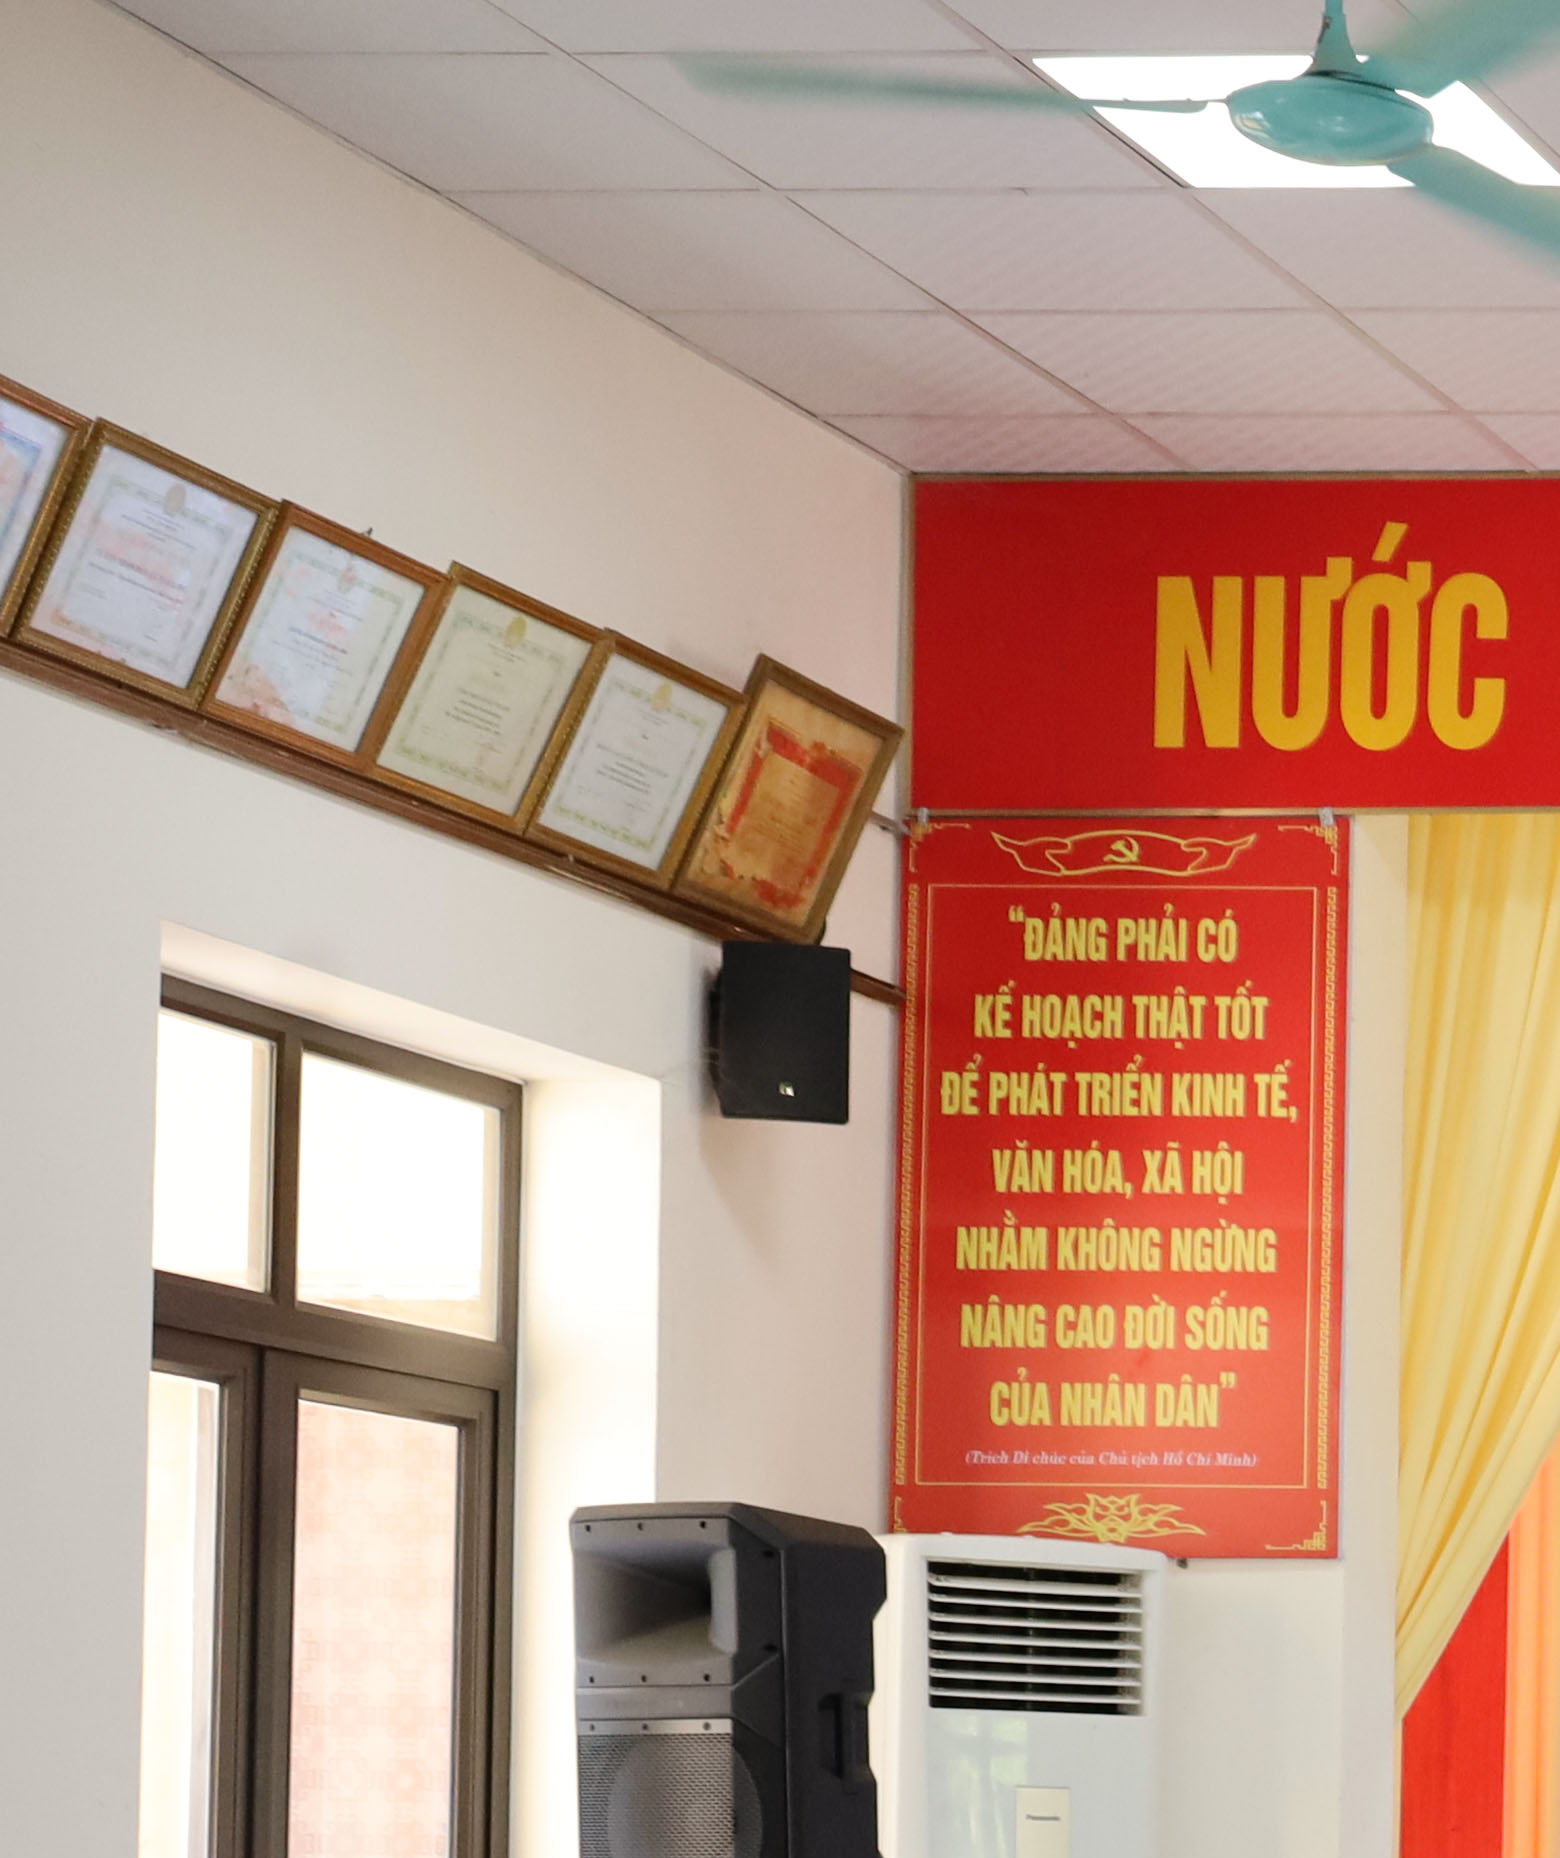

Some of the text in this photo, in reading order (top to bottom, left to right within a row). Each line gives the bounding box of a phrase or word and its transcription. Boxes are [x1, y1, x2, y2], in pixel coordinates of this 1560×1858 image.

[1155, 522, 1508, 751] NƯỚC
[1116, 903, 1189, 962] PHẢI
[1196, 909, 1239, 963] CÓ
[973, 980, 1270, 1049] KẾ HOẠCH THẬT TỐT
[940, 1054, 1299, 1121] ĐỂ PHÁT TRIỂN KINH TẾ,
[991, 1138, 1245, 1204] VĂN HÓA, XÃ HỘI
[955, 1210, 1279, 1273] NHẰM KHÔNG NGỪNG
[959, 1290, 1271, 1351] NÂNG CAO ĐỜI SỐNG
[988, 1367, 1054, 1427] CỦA
[1059, 1372, 1149, 1428] NHÂN
